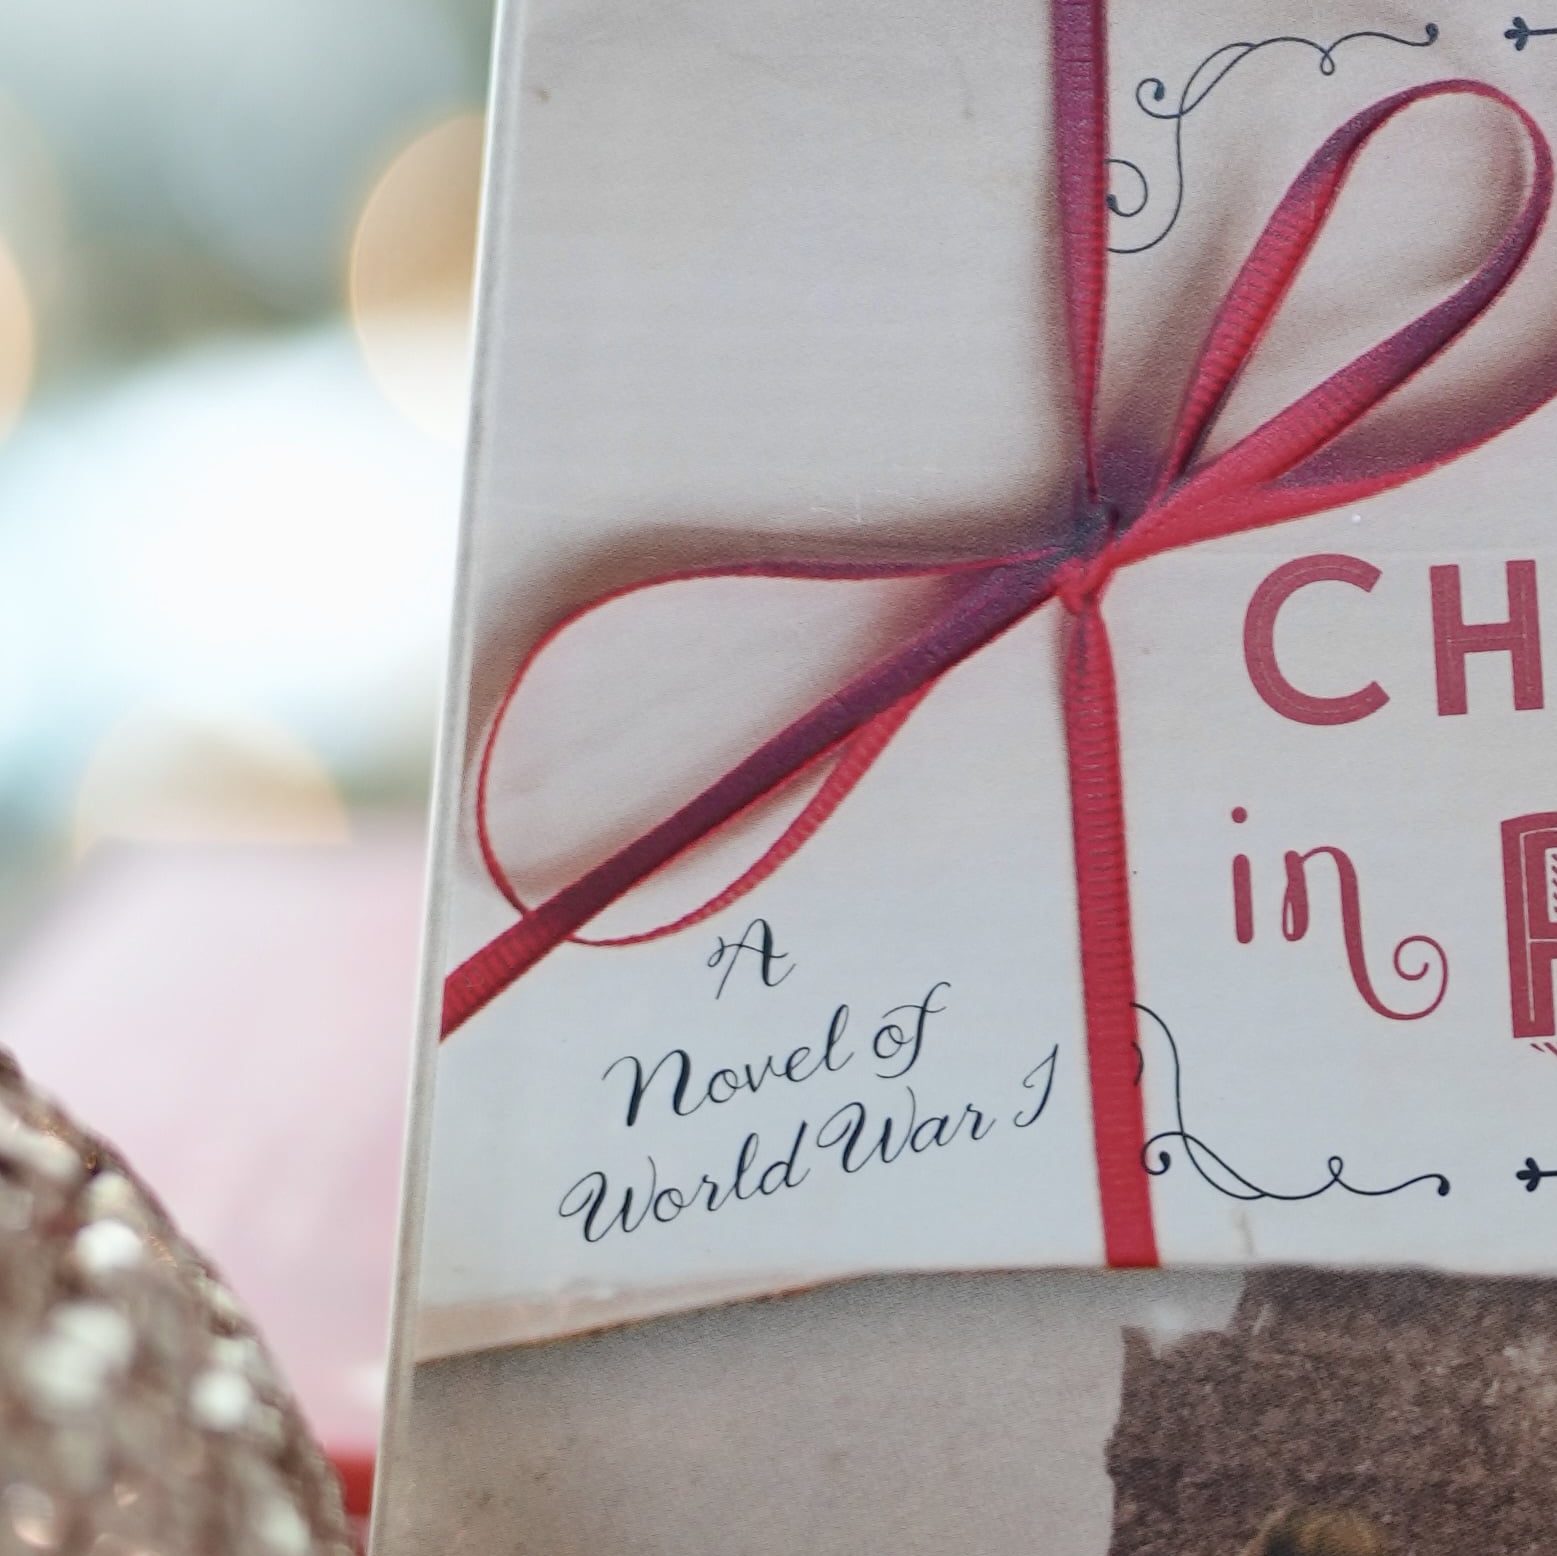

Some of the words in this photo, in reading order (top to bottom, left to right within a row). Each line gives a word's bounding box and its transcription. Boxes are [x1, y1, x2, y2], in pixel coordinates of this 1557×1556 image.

[705, 917, 797, 1001] A
[1229, 804, 1450, 1023] in
[602, 1002, 855, 1128] Novel
[872, 980, 952, 1080] of
[557, 1119, 811, 1243] World
[815, 1085, 996, 1174] War
[1012, 1043, 1060, 1128] I
